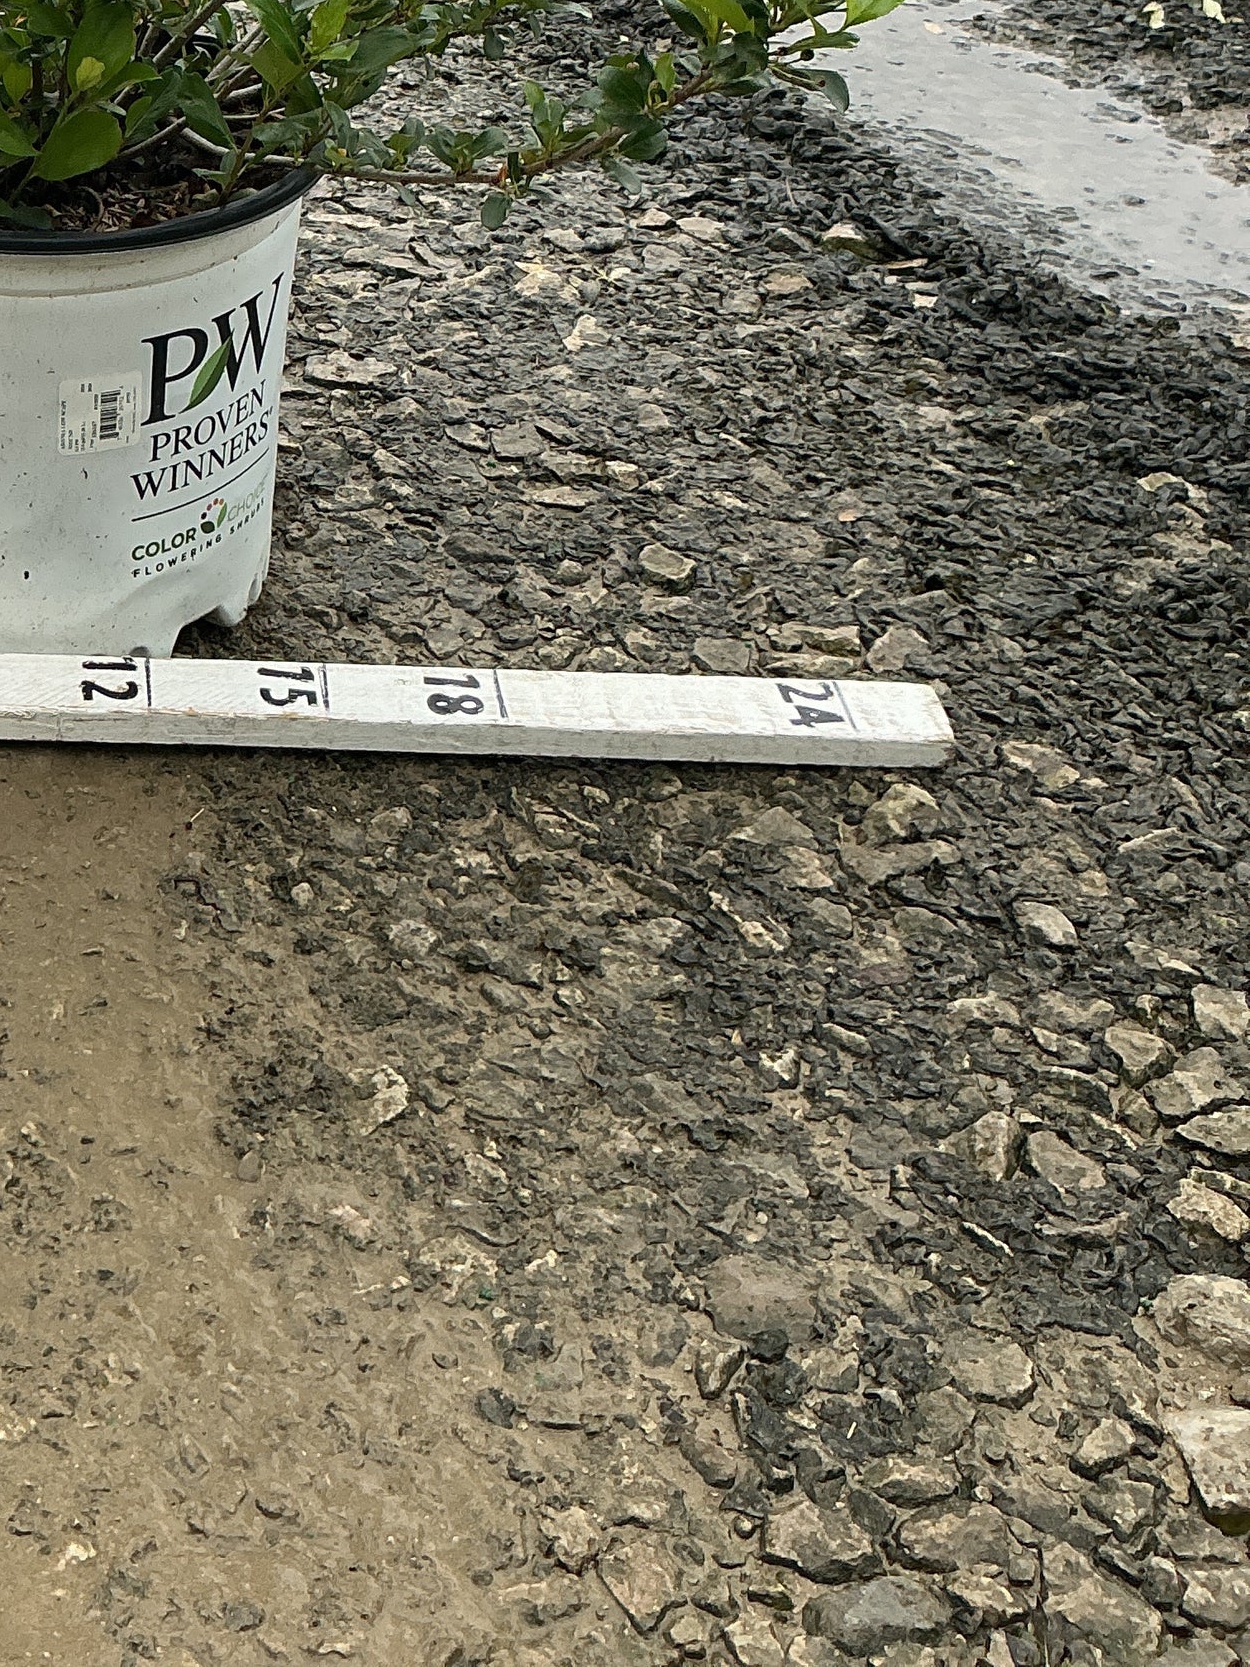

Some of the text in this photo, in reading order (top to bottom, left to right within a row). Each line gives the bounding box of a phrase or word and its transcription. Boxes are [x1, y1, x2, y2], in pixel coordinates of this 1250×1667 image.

[140, 271, 285, 427] PW
[149, 379, 266, 463] PROVEN
[131, 526, 197, 561] COLOR
[132, 533, 222, 579] FLOWERING
[80, 655, 140, 701] 12
[256, 666, 318, 708] 15
[423, 673, 485, 716] 18
[776, 681, 845, 729] 24
